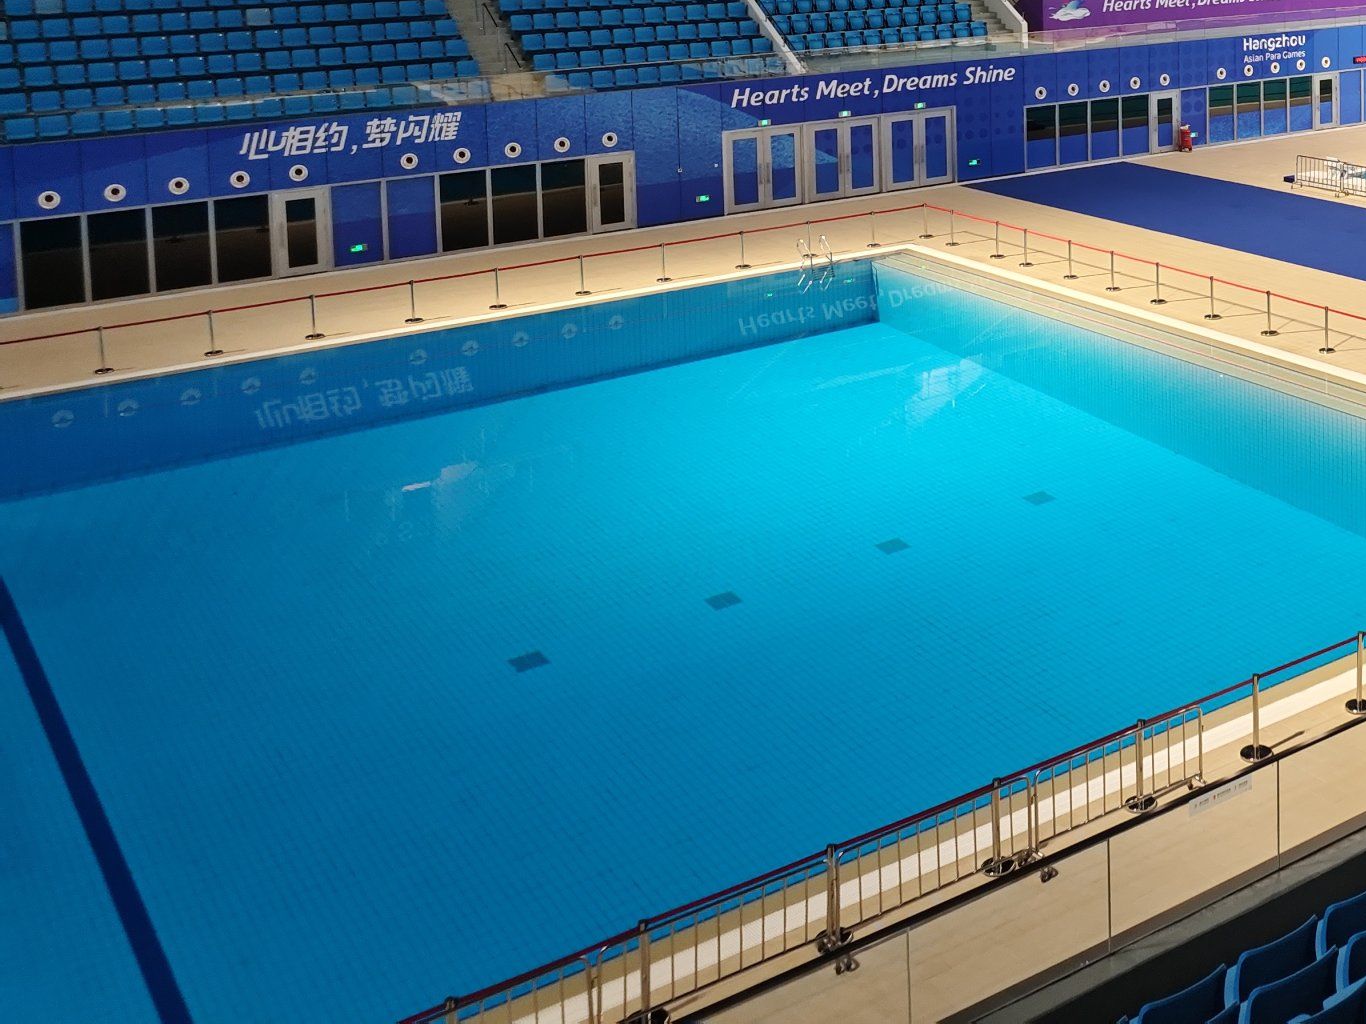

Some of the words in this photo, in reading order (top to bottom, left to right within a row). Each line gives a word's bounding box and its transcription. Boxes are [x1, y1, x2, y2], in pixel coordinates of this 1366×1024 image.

[1243, 33, 1306, 52] Hangzhou
[1243, 54, 1264, 64] Asian
[1265, 52, 1281, 61] Para
[1282, 50, 1306, 59] Games
[731, 84, 809, 109] Hearts
[882, 72, 958, 94] Dreams
[963, 64, 1016, 86] Shine
